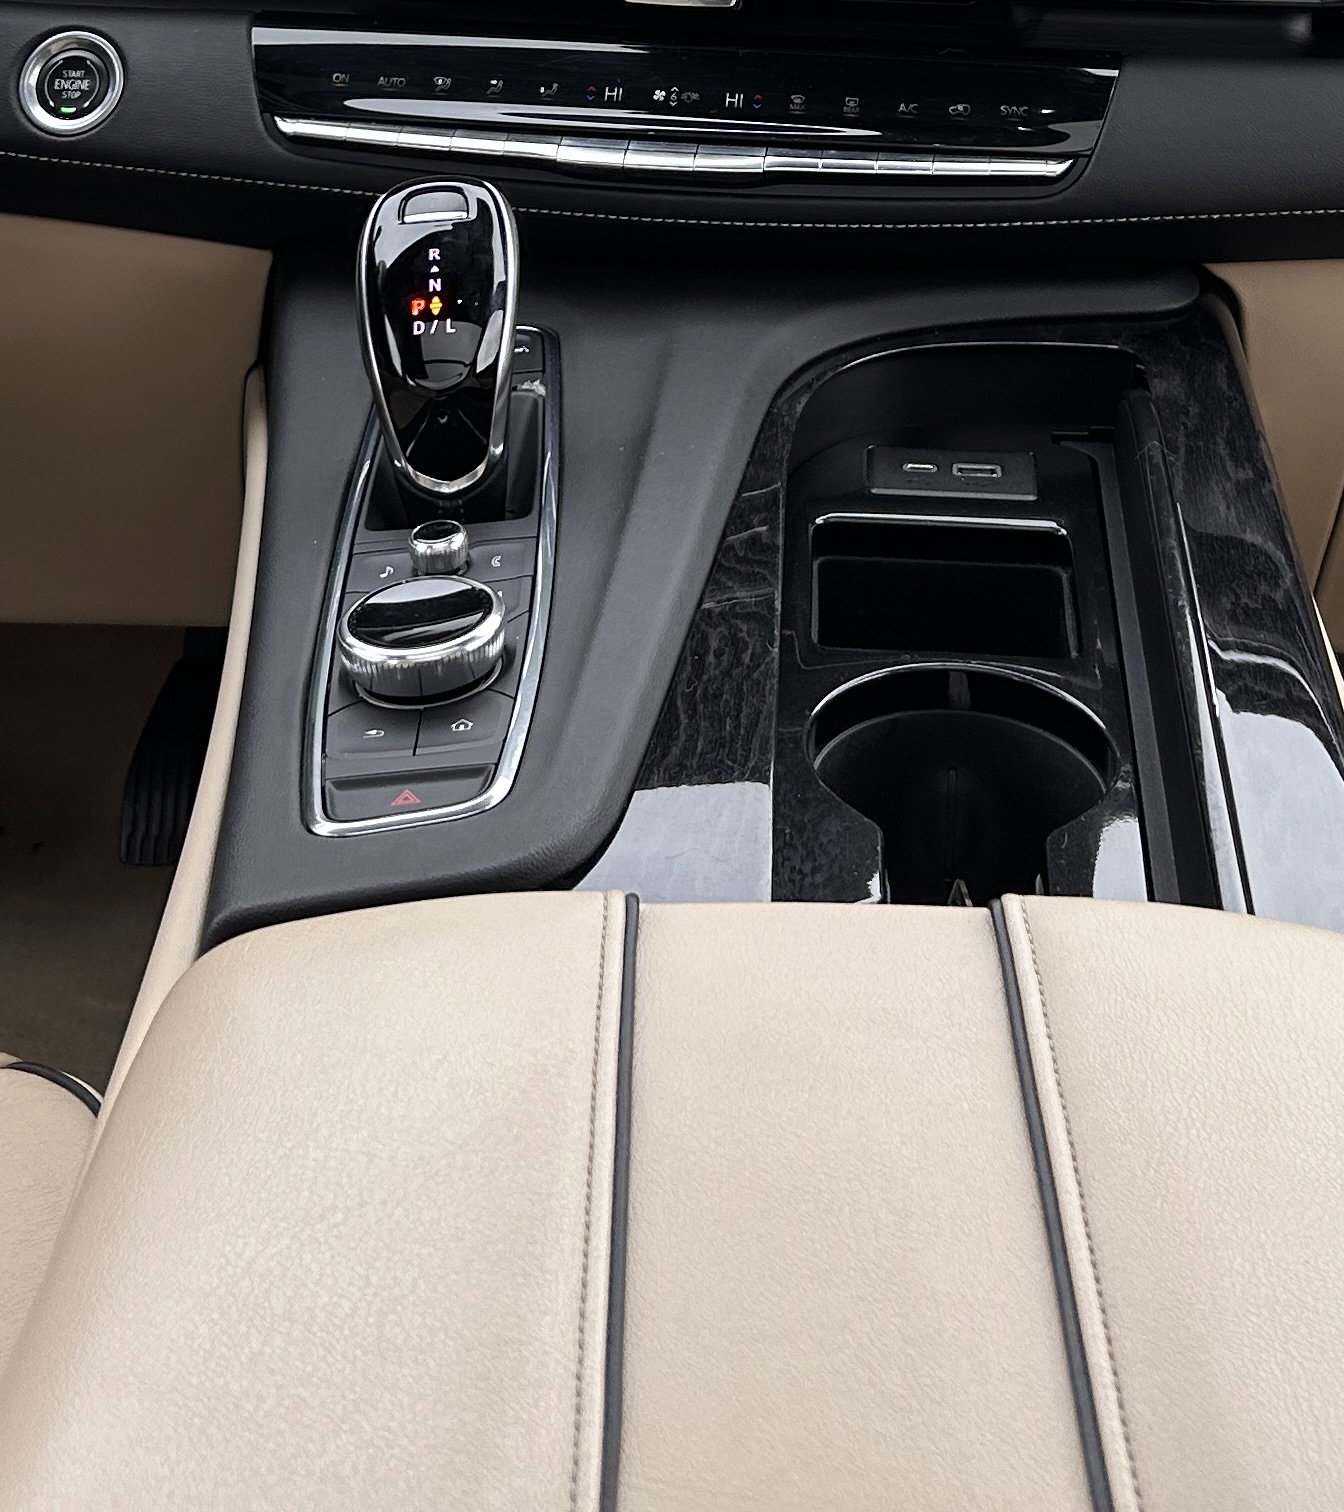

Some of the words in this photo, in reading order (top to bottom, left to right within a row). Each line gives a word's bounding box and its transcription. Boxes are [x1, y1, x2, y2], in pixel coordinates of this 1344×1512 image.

[62, 69, 86, 78] START
[332, 72, 350, 84] ON
[54, 78, 91, 91] ENGINE
[377, 75, 407, 88] AUTO
[61, 90, 82, 100] STOP
[603, 86, 624, 102] HI
[670, 92, 678, 101] 6
[725, 92, 744, 109] HI
[898, 102, 919, 116] A/C
[999, 104, 1029, 117] SYNC
[428, 248, 441, 261] R
[428, 278, 442, 292] N
[412, 300, 426, 316] P
